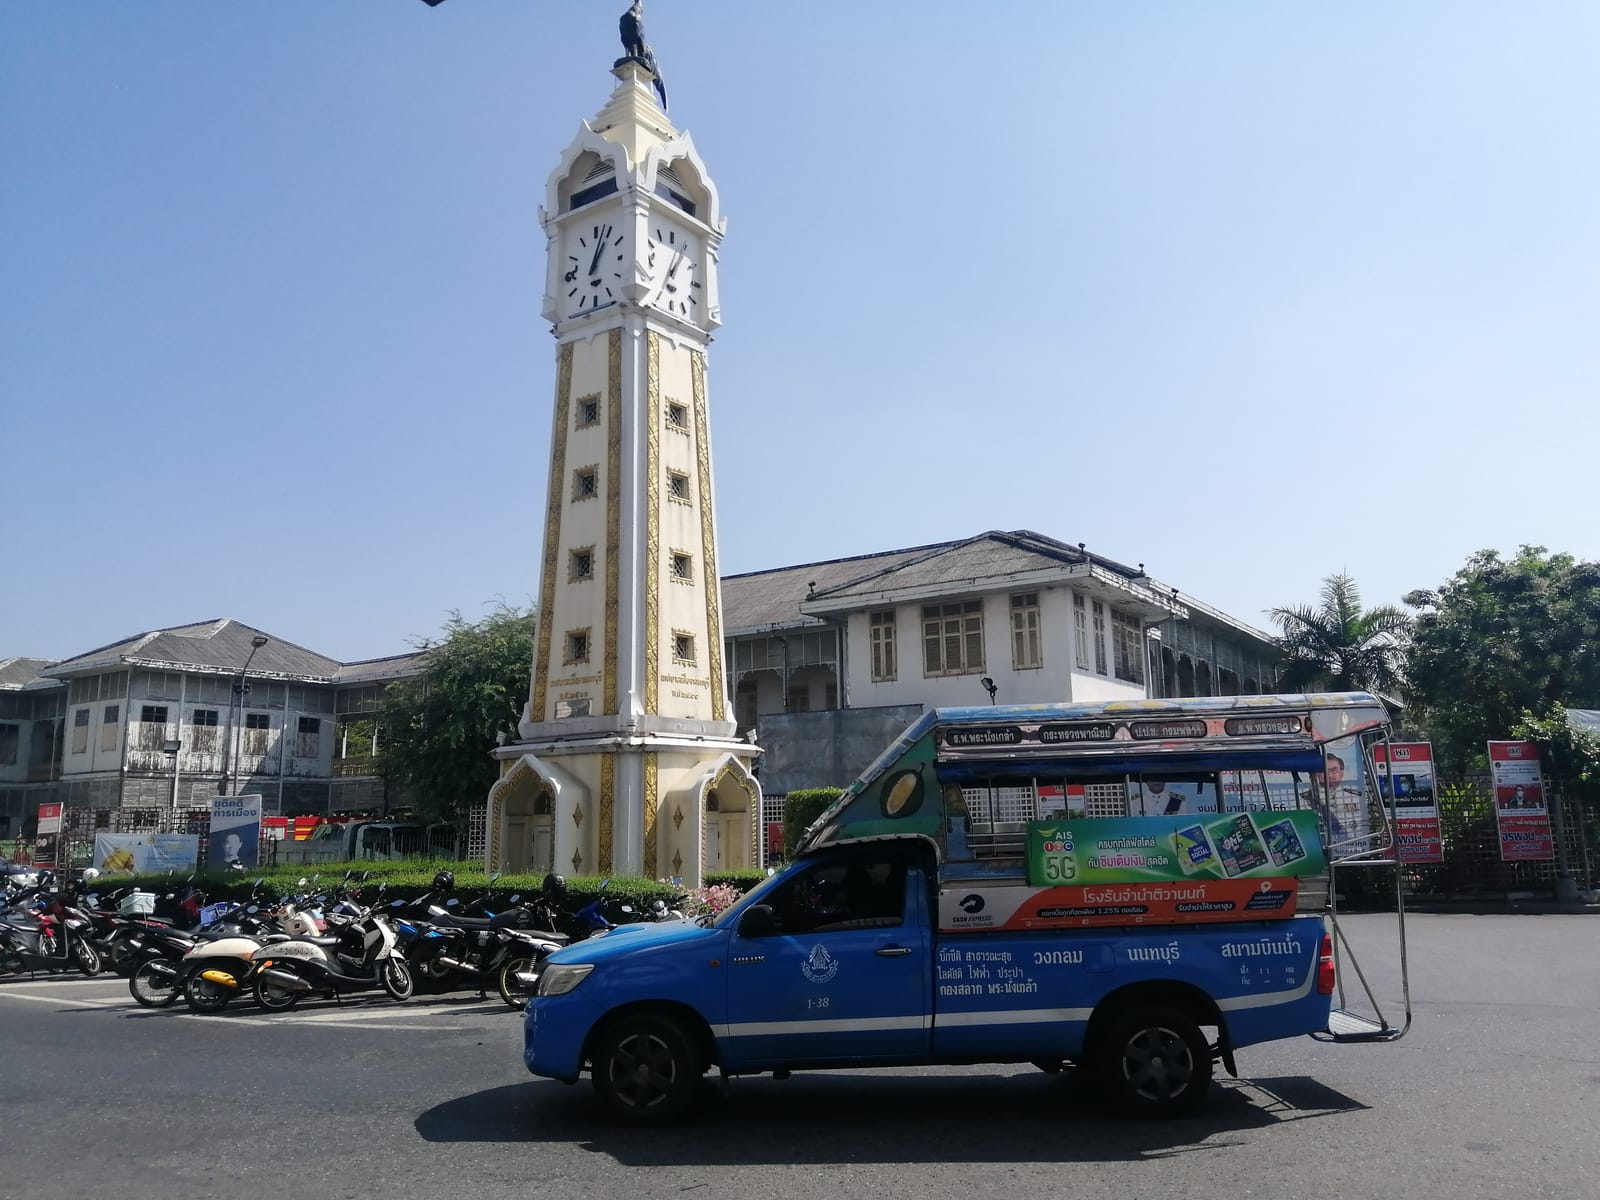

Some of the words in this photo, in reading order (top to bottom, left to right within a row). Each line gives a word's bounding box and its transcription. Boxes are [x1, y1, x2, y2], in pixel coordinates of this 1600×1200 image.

[1042, 726, 1111, 740] กระทรวงพาณิชย์
[1260, 803, 1286, 812] 266
[1055, 831, 1073, 840] AIS
[1046, 856, 1076, 879] 5G
[1083, 884, 1206, 904] โรงรับจำนำติวานนท์
[1128, 940, 1181, 965] นนทบุรี
[1221, 932, 1302, 958] สนามบินน้ำ
[1033, 950, 1083, 965] วงกลม
[968, 964, 990, 979] ไฟฟ้า
[997, 966, 1024, 978] ประปา
[988, 978, 1037, 994] พระนั่งเกล้า
[808, 998, 830, 1009] 1-38
